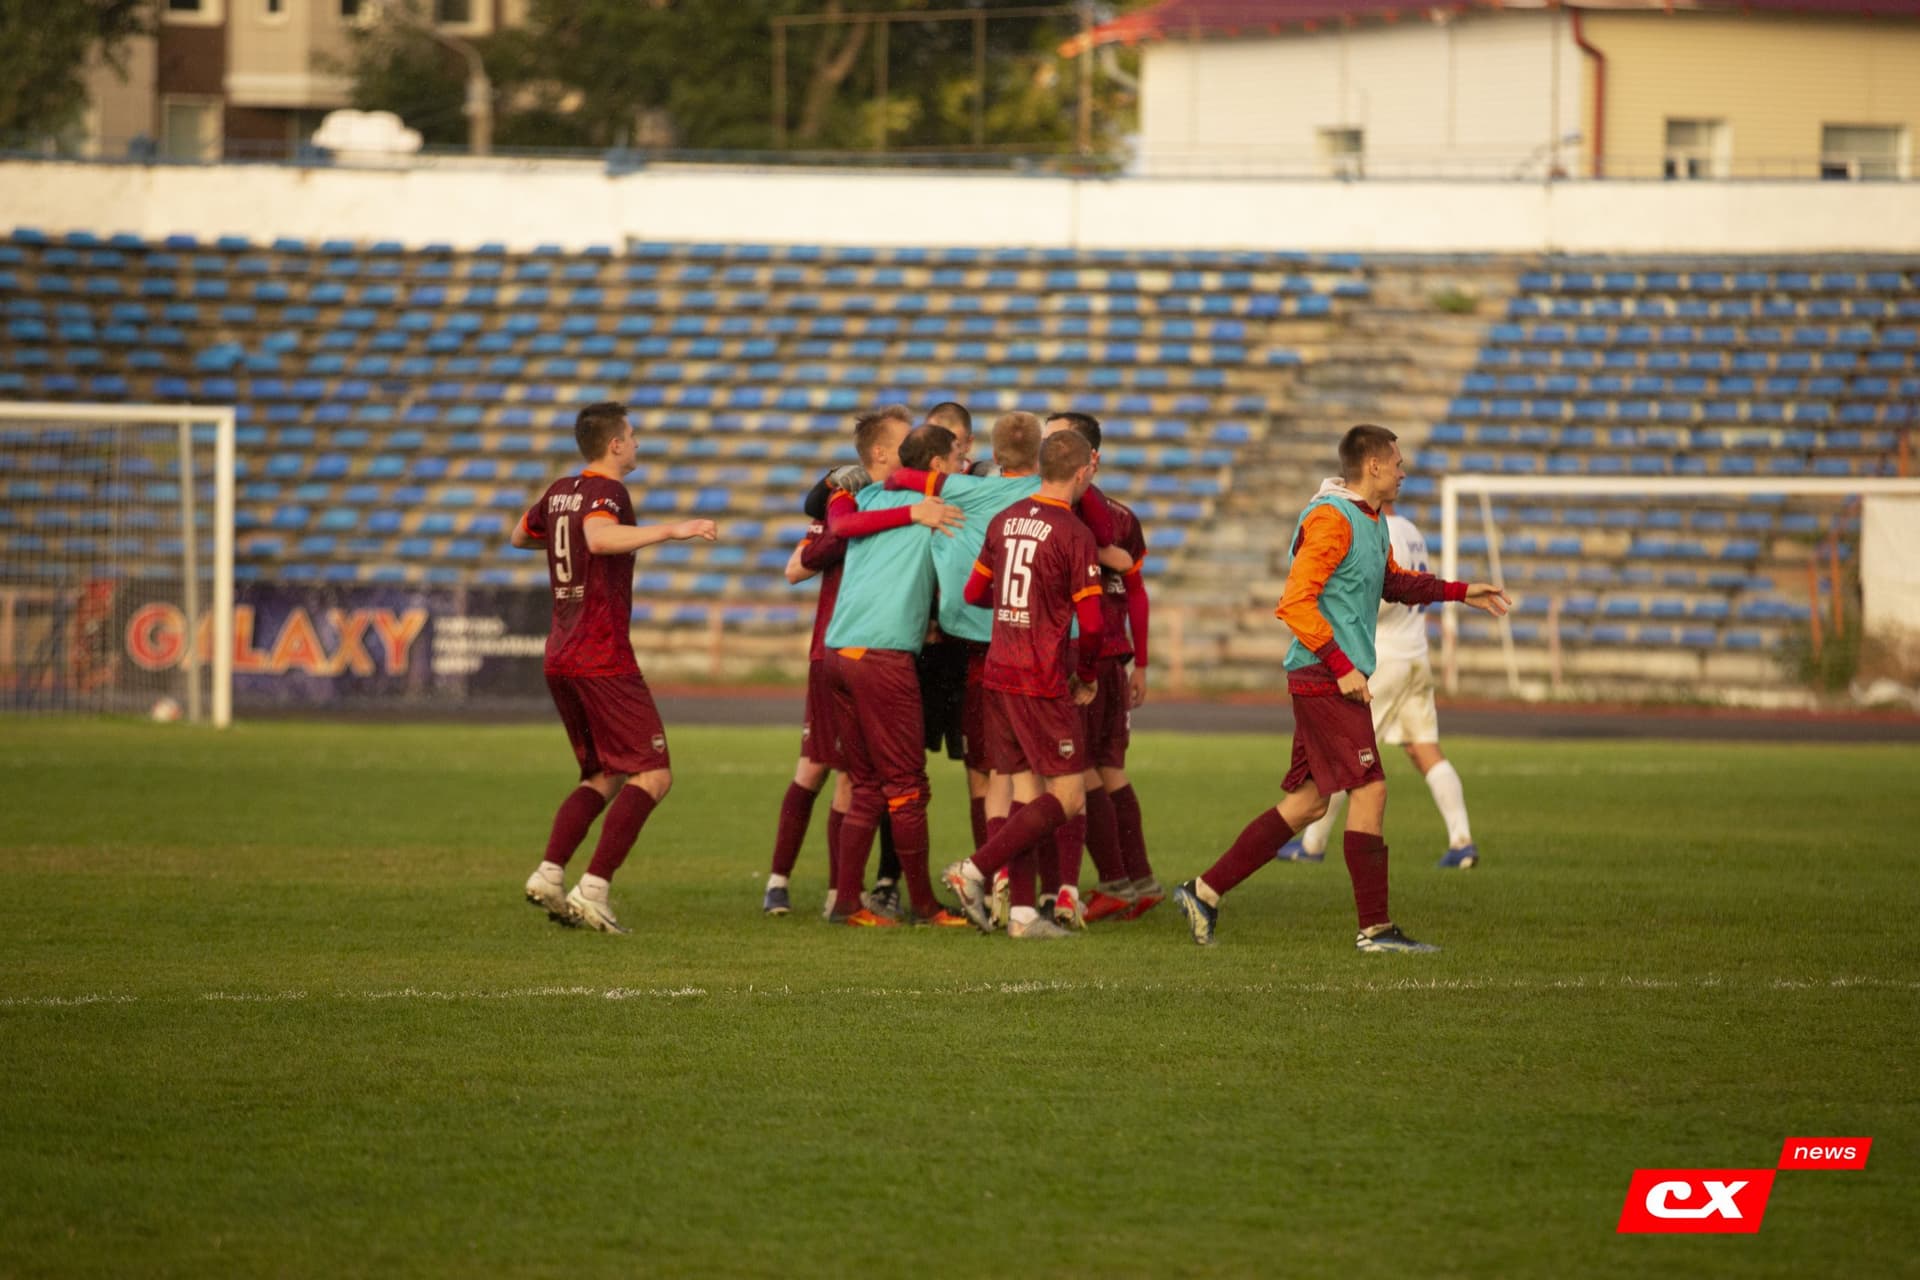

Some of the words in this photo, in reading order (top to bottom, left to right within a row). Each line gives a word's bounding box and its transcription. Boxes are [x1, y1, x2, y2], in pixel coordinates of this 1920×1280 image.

[555, 515, 573, 583] 9
[1003, 517, 1053, 542] БЕЛИКОВ
[1002, 538, 1038, 608] 15
